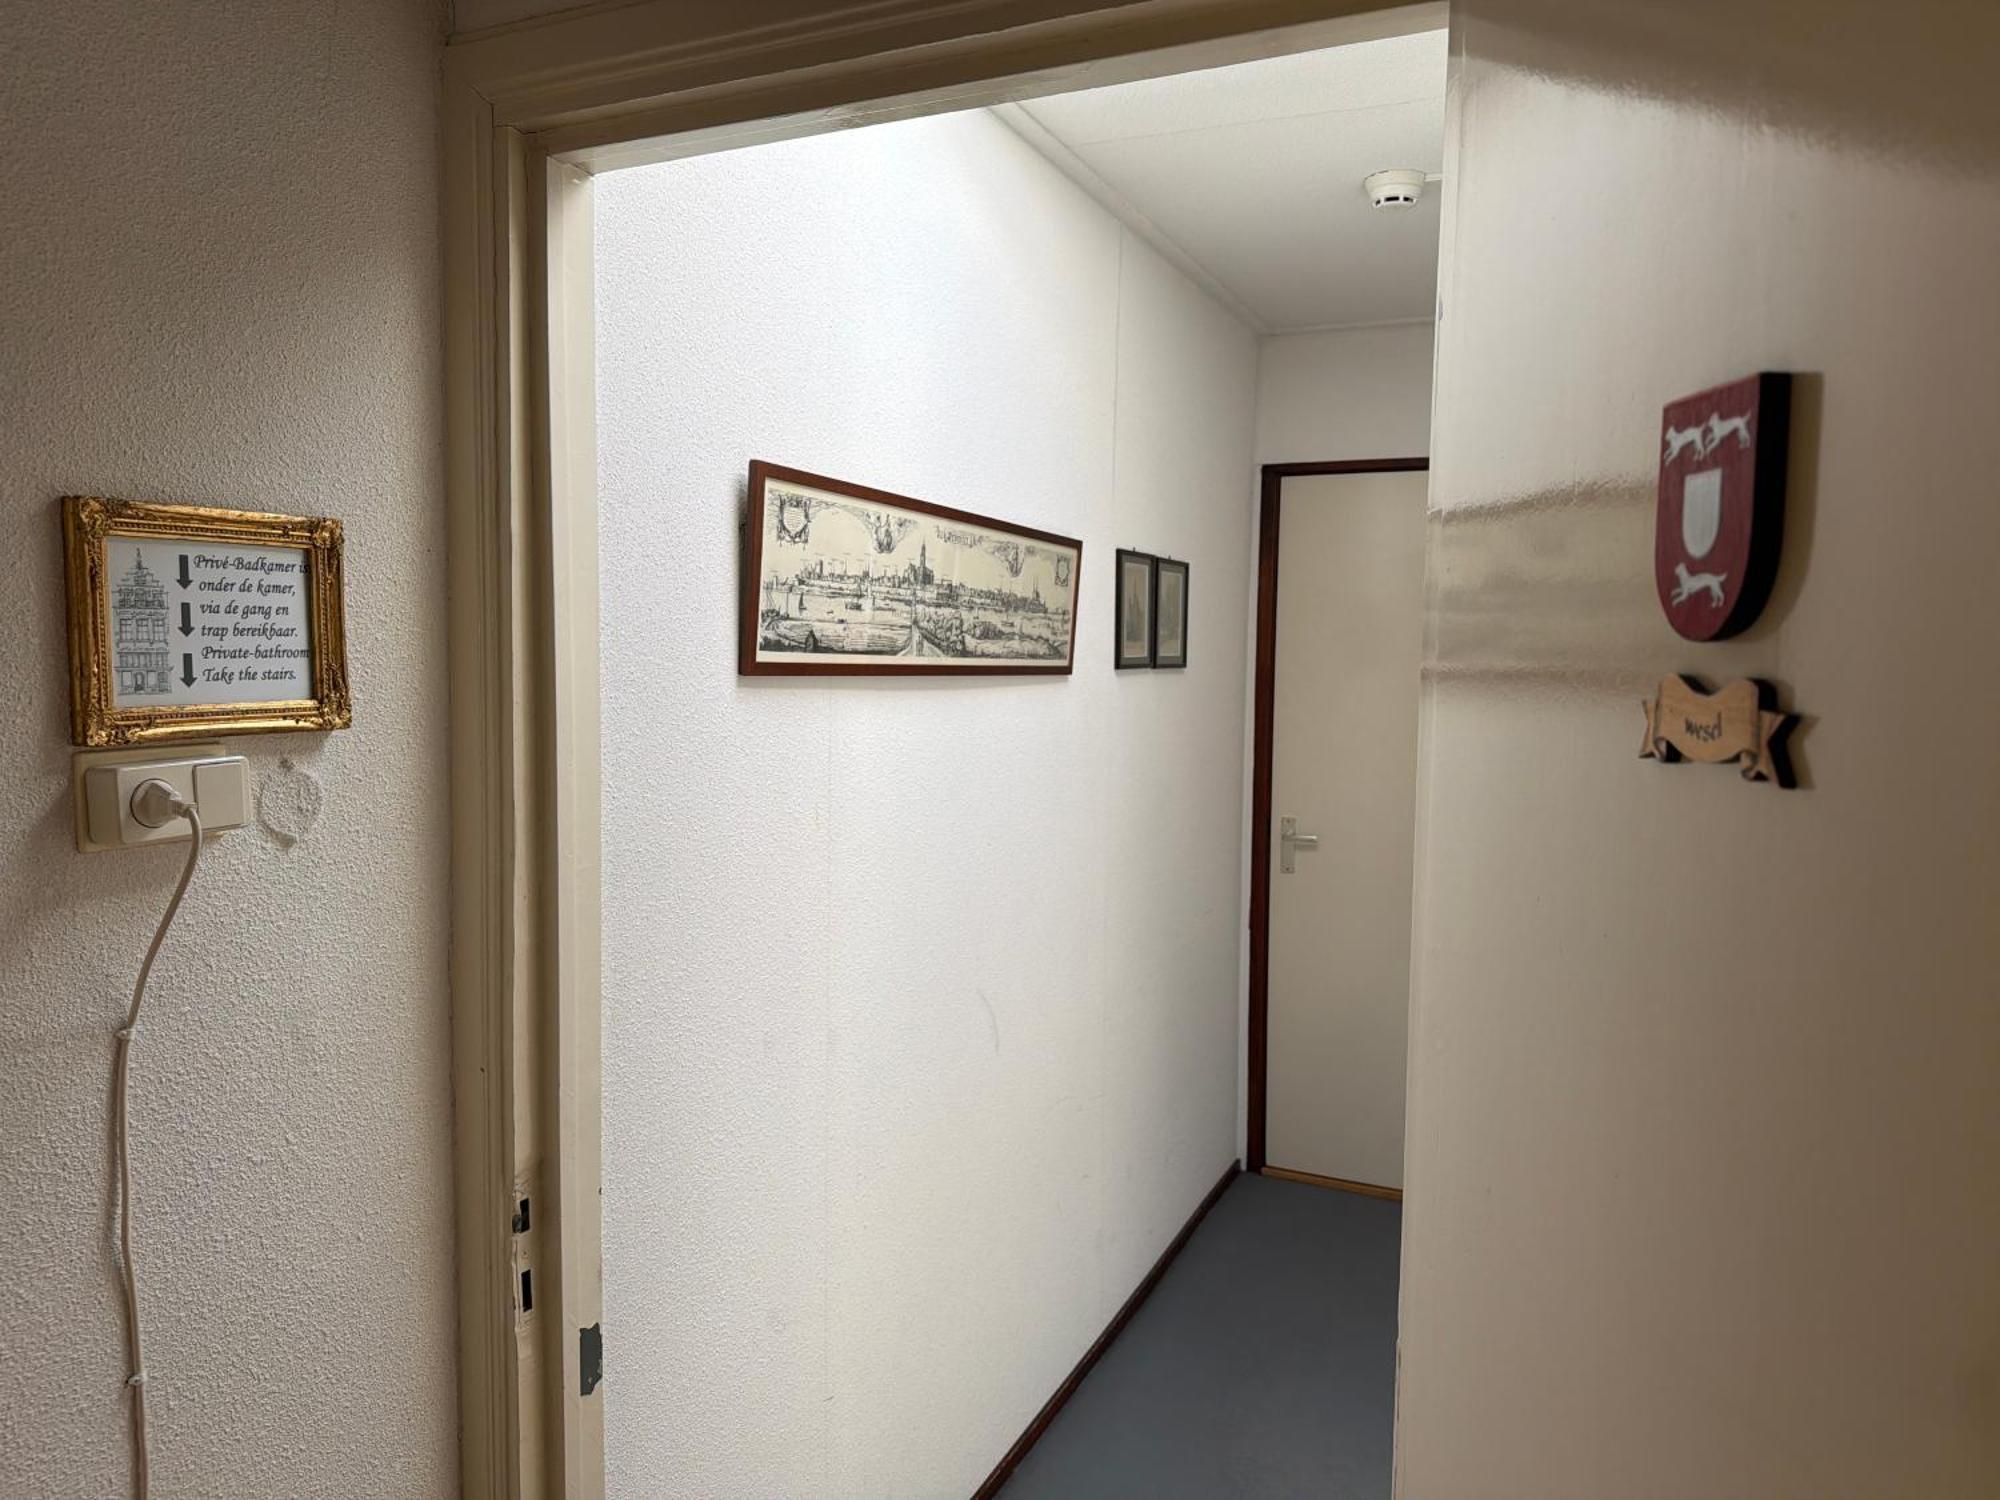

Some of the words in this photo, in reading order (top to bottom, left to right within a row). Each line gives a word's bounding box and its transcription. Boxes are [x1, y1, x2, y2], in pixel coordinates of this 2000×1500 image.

[193, 554, 295, 575] Privé-Badkamer
[199, 577, 236, 593] onder
[239, 577, 253, 593] de
[257, 578, 296, 597] kamer,
[200, 600, 220, 615] via
[224, 600, 239, 615] de
[241, 603, 272, 620] gang
[275, 605, 289, 616] en
[201, 624, 229, 641] trap
[232, 621, 299, 641] bereikbaar.
[201, 643, 310, 660] Private-bathroom
[202, 665, 234, 685] Take
[238, 665, 258, 681] the
[260, 666, 297, 681] stairs.
